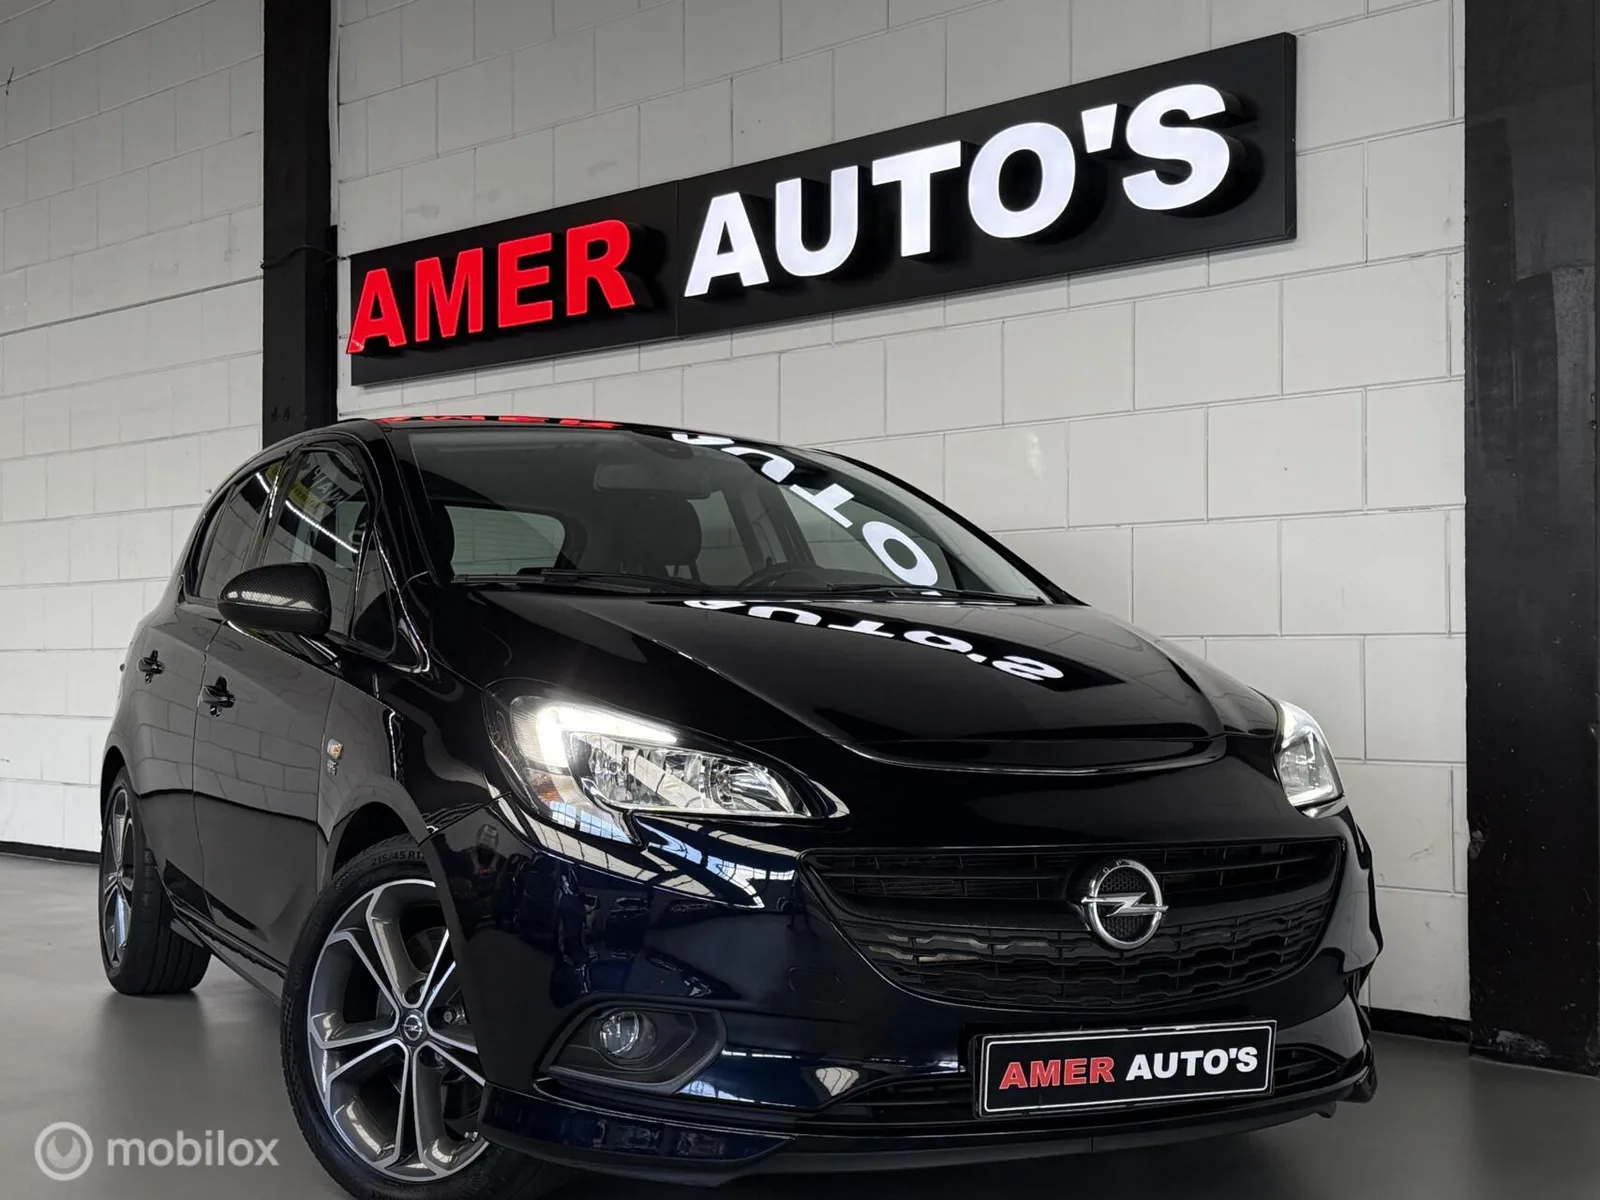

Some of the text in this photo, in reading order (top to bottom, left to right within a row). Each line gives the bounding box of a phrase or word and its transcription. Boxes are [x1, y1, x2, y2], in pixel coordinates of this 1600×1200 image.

[346, 84, 1230, 355] AMER AUTO'S
[999, 1046, 1259, 1090] AMER AUTO'S
